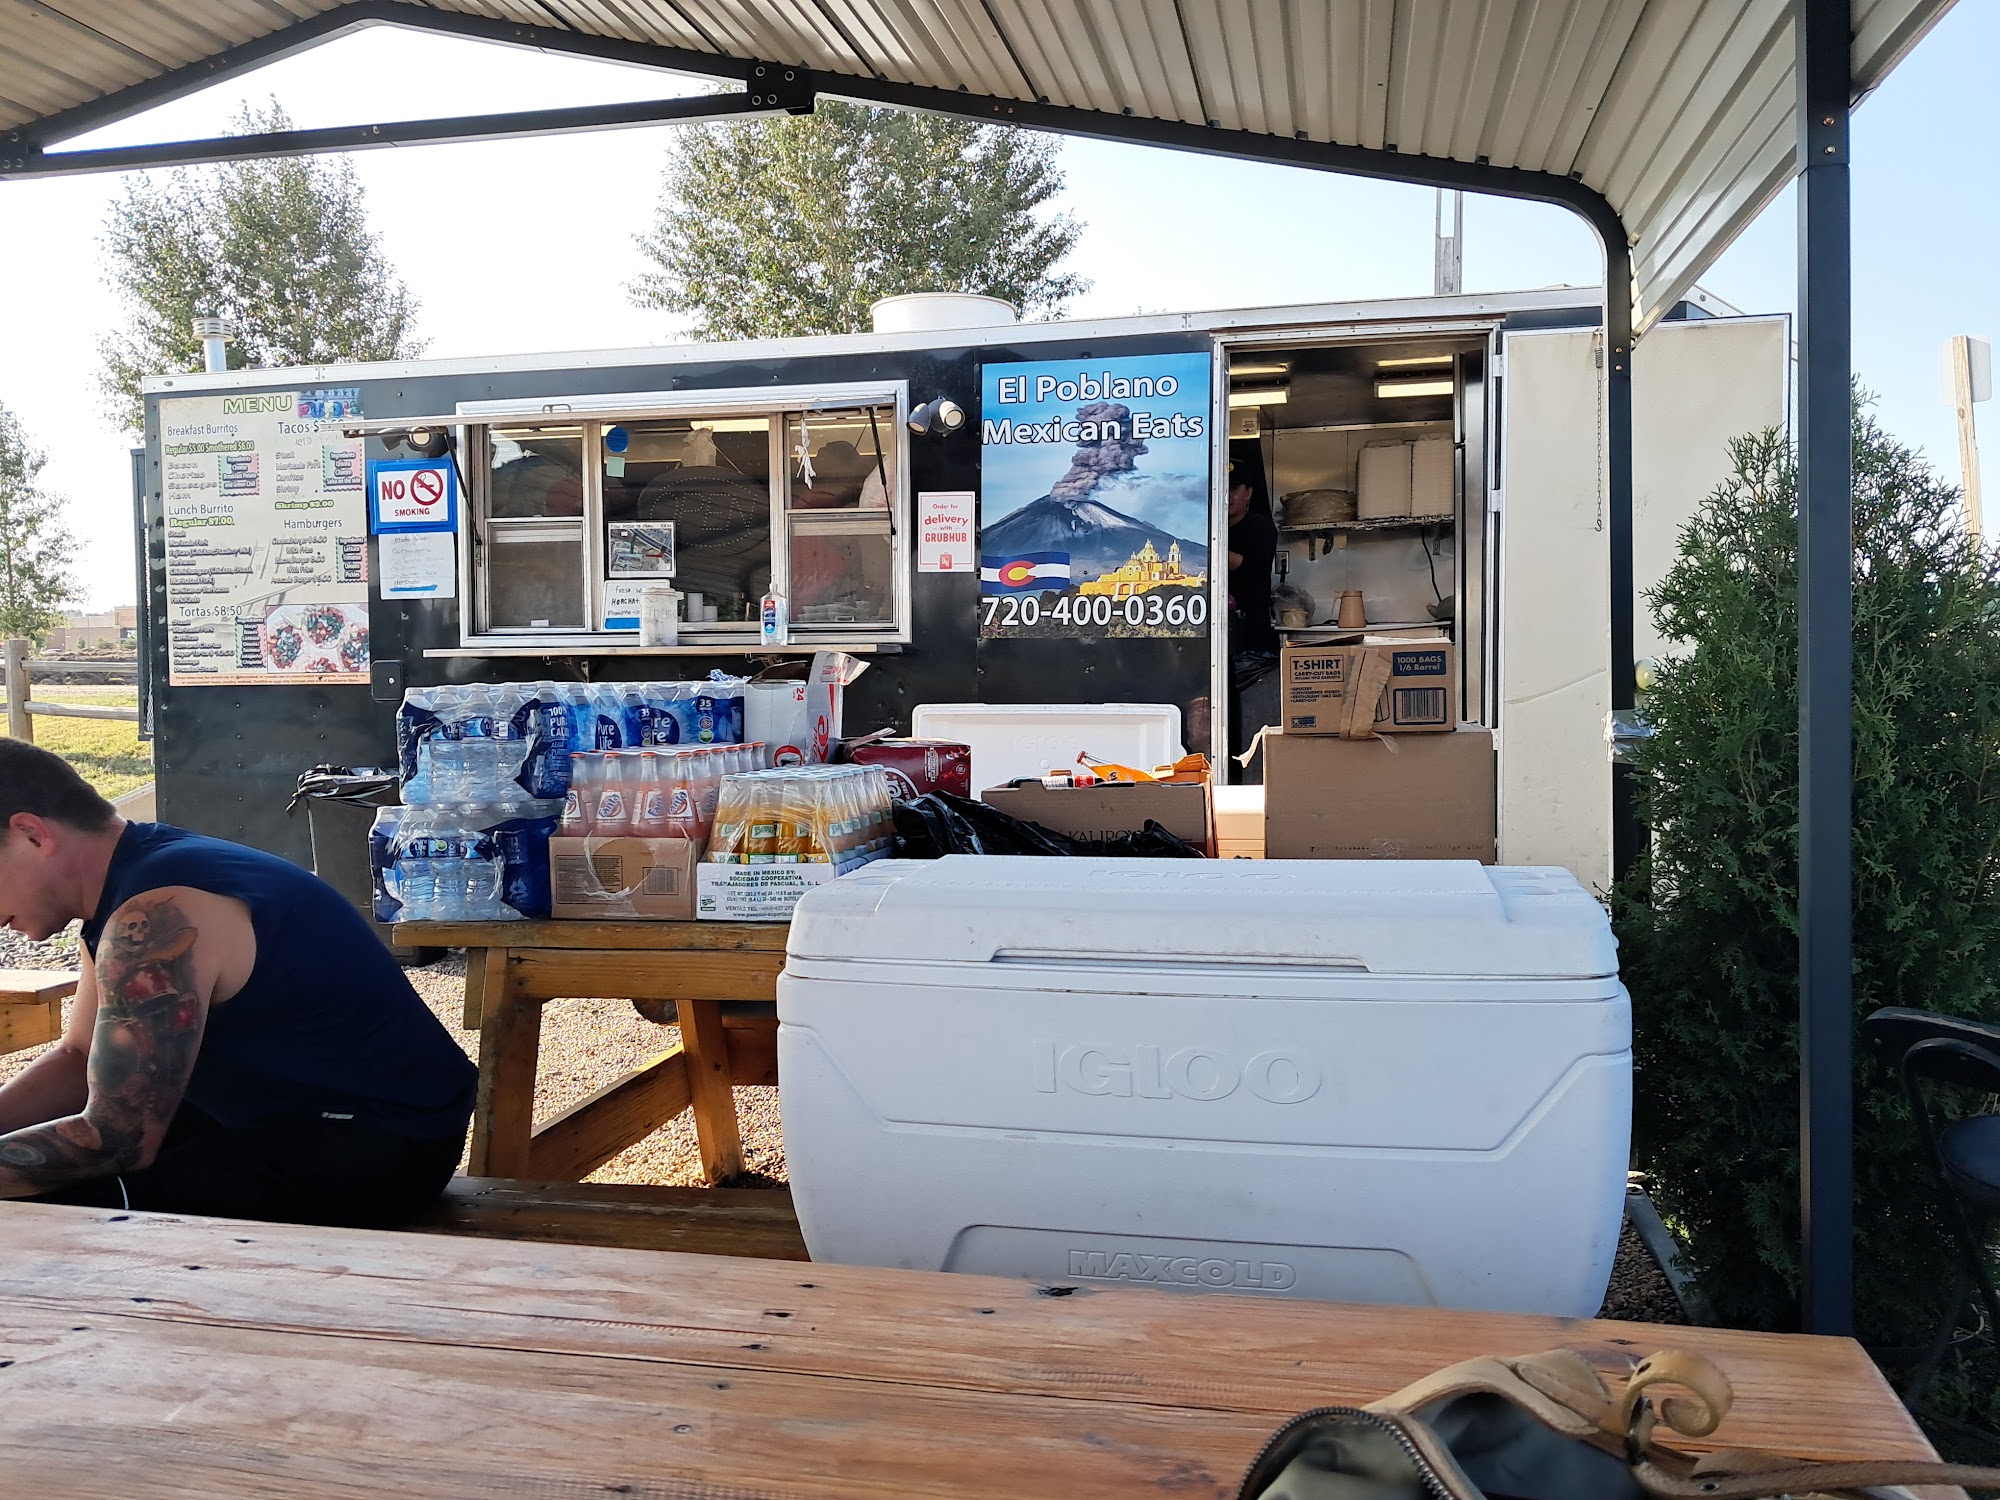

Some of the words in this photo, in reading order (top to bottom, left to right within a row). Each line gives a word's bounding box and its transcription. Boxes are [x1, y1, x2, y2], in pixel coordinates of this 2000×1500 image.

[998, 375, 1028, 405] El
[1035, 371, 1179, 403] Poblano
[223, 395, 292, 414] MENU
[167, 424, 205, 436] Breakfast
[206, 423, 238, 434] Burritos
[277, 421, 310, 434] Tacos
[981, 416, 1121, 446] Mexican
[1131, 412, 1204, 440] Eats
[165, 444, 188, 457] Regular
[205, 441, 237, 453] Smothered
[237, 440, 254, 452] $6.00
[381, 479, 405, 501] NO
[168, 504, 197, 515] Lunch
[200, 503, 234, 514] Burrito
[275, 501, 309, 510] Shrimp
[309, 500, 334, 508] $3.00
[394, 508, 430, 517] SMOKING
[169, 517, 208, 528] Regular
[208, 516, 233, 525] $7.00
[284, 519, 342, 530] Hamburgers
[924, 513, 969, 527] delivery
[338, 537, 364, 545] Ingredients
[925, 532, 967, 543] GRUBHUB
[179, 606, 211, 617] Tortas
[981, 594, 1208, 628] 720-400-0360
[1293, 659, 1342, 671] T-SHIRT
[1396, 656, 1416, 664] 1000
[1418, 655, 1442, 663] BAGS
[1399, 664, 1412, 672] 1/6
[1414, 662, 1440, 671] Barrel
[796, 687, 804, 702] 24
[699, 699, 712, 708] 35
[641, 708, 650, 718] 35
[600, 791, 621, 818] Fanta
[1032, 1040, 1322, 1104] IGLOO
[1068, 1248, 1296, 1291] MAXCOLD
